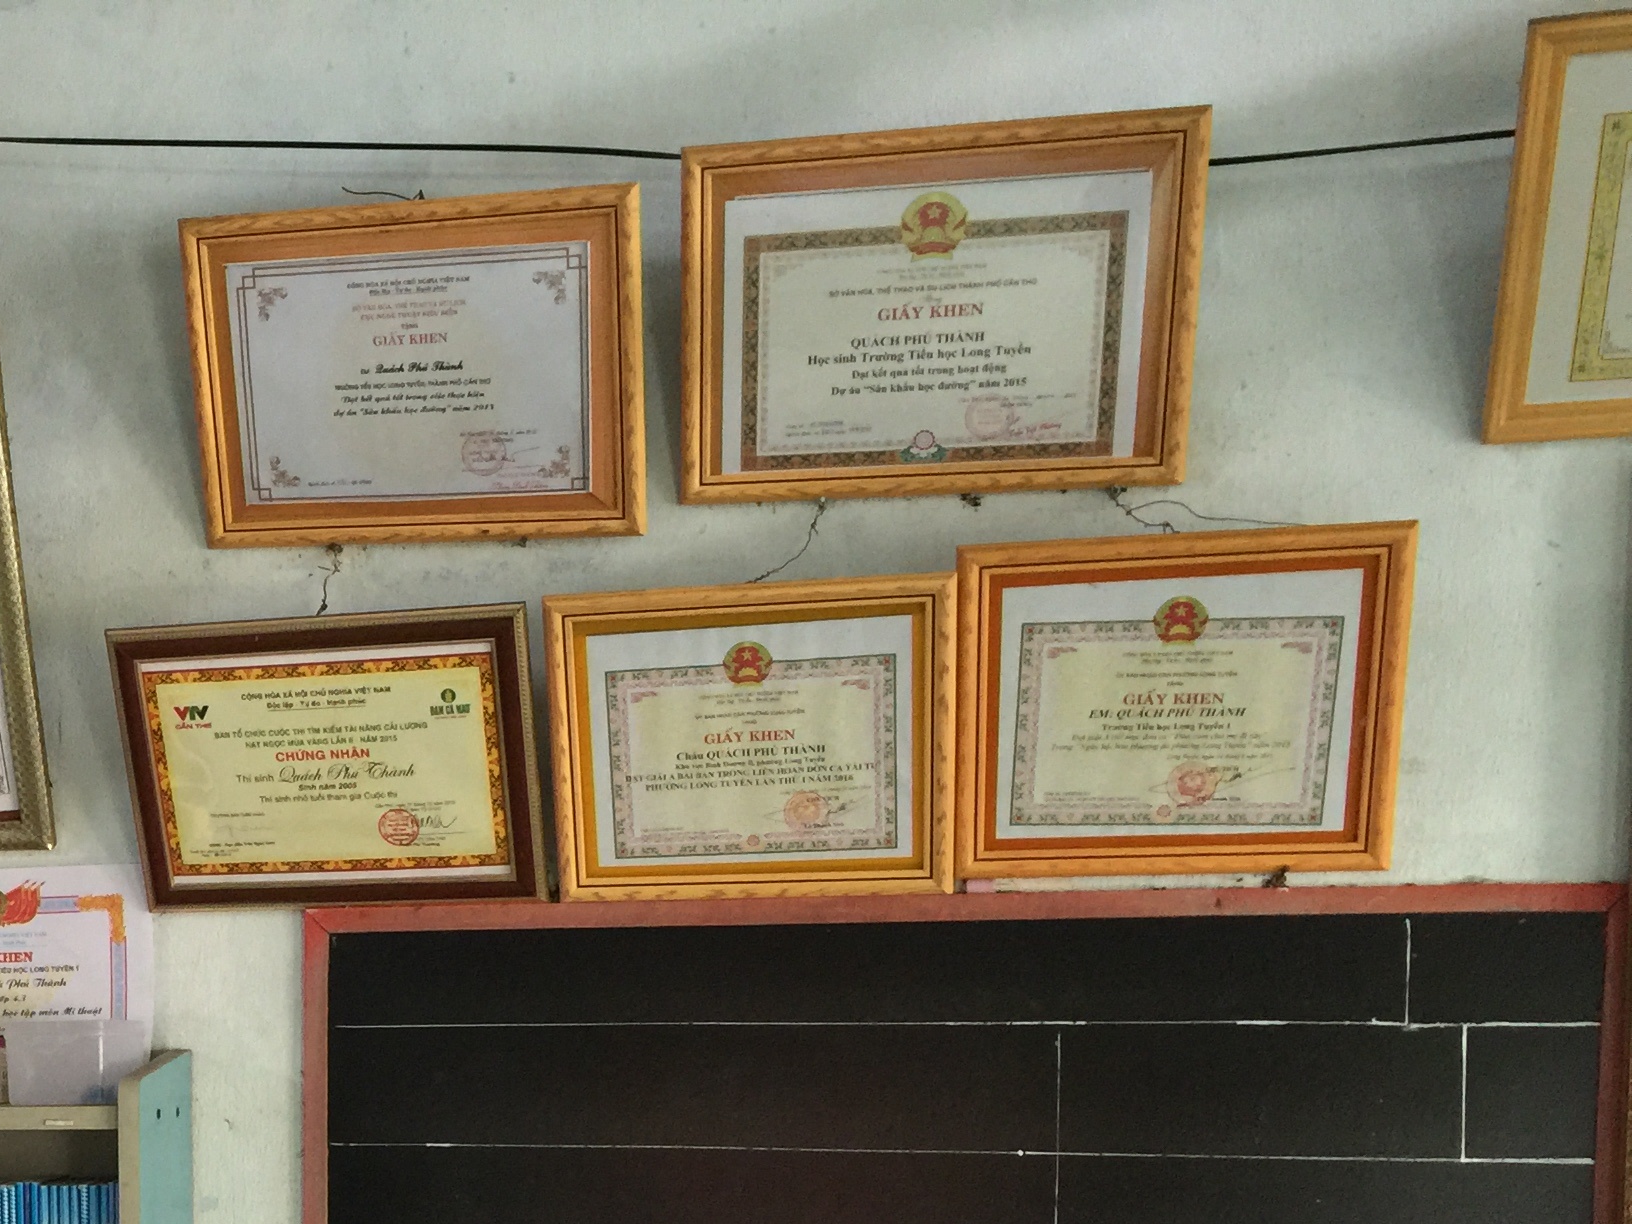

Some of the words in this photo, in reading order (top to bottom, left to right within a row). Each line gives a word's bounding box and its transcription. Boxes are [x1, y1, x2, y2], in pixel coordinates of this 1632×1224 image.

[877, 302, 923, 321] GIẤY
[929, 302, 983, 319] KHEN
[372, 331, 405, 346] GIẤY
[409, 332, 448, 344] KHEN
[808, 355, 830, 367] Học
[834, 353, 856, 364] sinh
[938, 349, 956, 361] học
[961, 347, 990, 358] Long
[1004, 377, 1027, 388] 2015
[1123, 688, 1167, 705] GIẤY
[1173, 693, 1224, 704] KHEN
[173, 706, 209, 721] VTV
[704, 726, 743, 744] GIẤY
[749, 729, 795, 742] KHEN
[275, 748, 326, 763] CHỨNG
[330, 746, 370, 760] NHẬN
[255, 774, 274, 782] sinh
[278, 765, 321, 783] Quách
[363, 761, 415, 779] Thành
